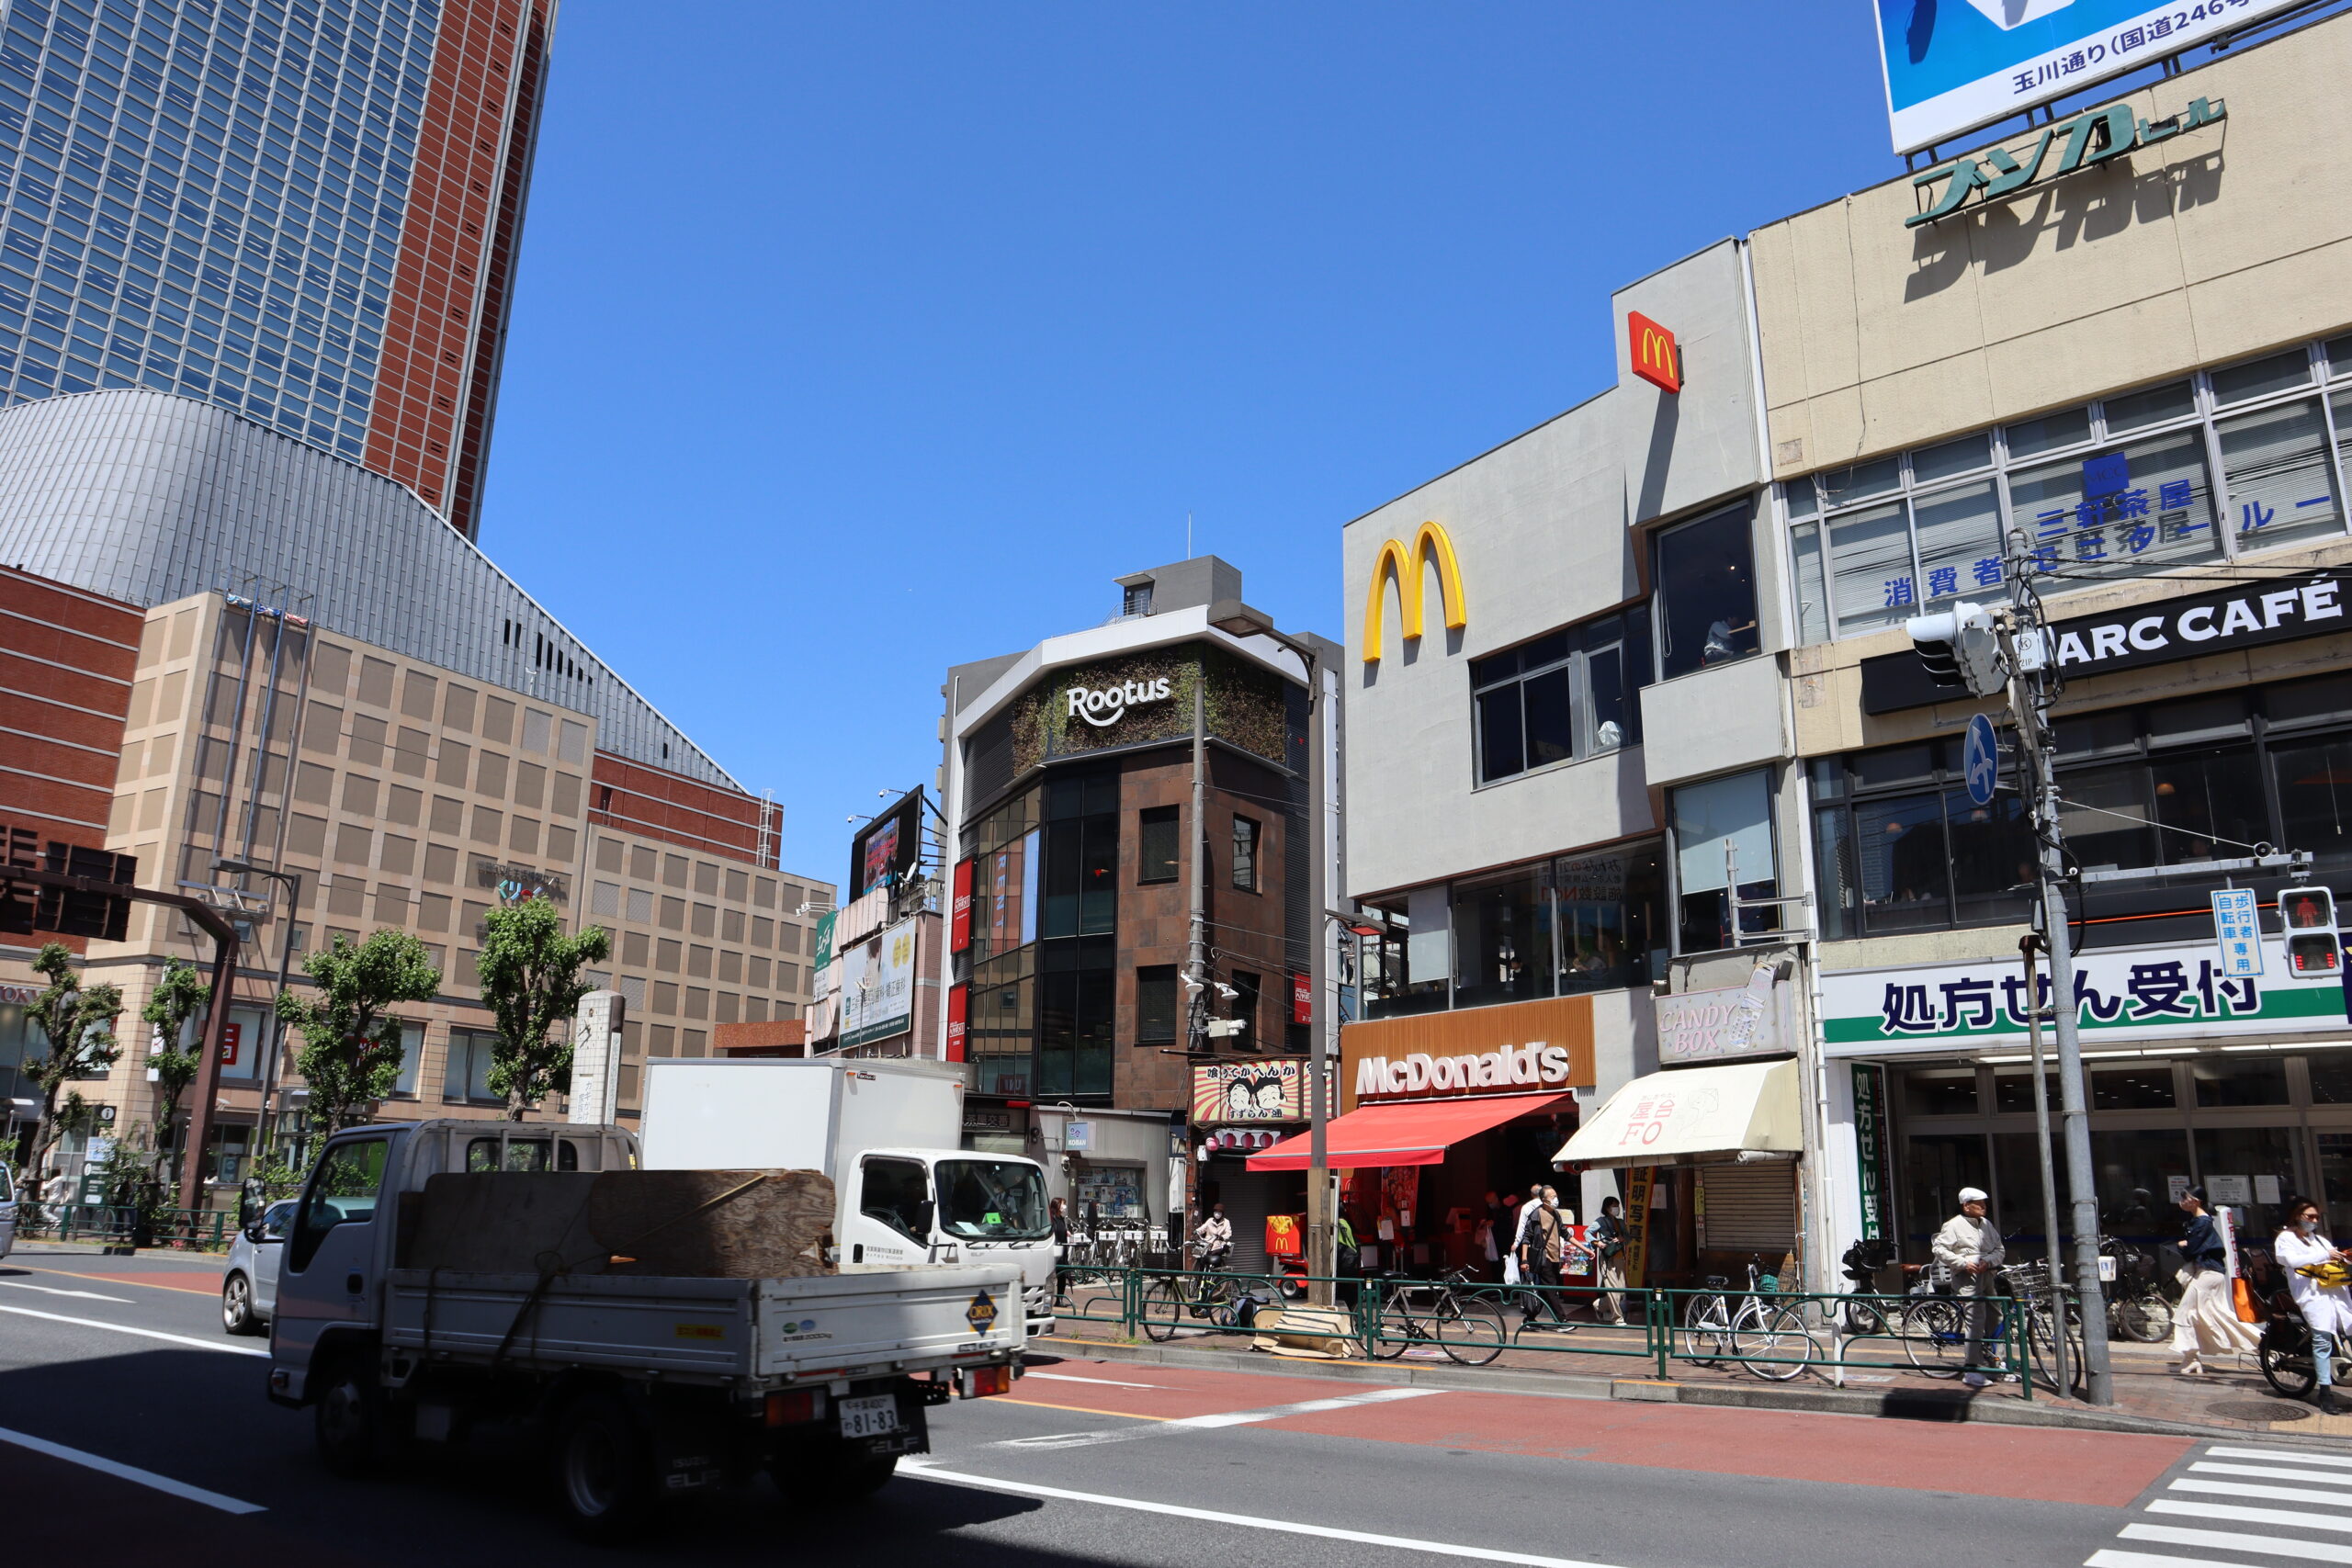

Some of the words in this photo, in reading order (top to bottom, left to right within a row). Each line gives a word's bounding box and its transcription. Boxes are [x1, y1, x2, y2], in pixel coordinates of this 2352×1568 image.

[2036, 479, 2194, 538] 三軒茶屋
[2041, 615, 2169, 669] ARC
[2177, 571, 2343, 642] CAFÉ
[1067, 677, 1170, 727] Rootus
[2219, 897, 2237, 939] 自転車
[2234, 895, 2253, 939] 歩行者
[2233, 942, 2251, 972] 専用
[1883, 959, 2262, 1032] 処方せん受付
[1659, 1003, 1737, 1032] CANDY
[1675, 1028, 1721, 1054] BOX
[1355, 1041, 1569, 1096] McDonald's
[962, 1113, 1009, 1127] 茶屋交番
[1068, 1138, 1087, 1146] KOBAN
[854, 1409, 897, 1434] 81-83
